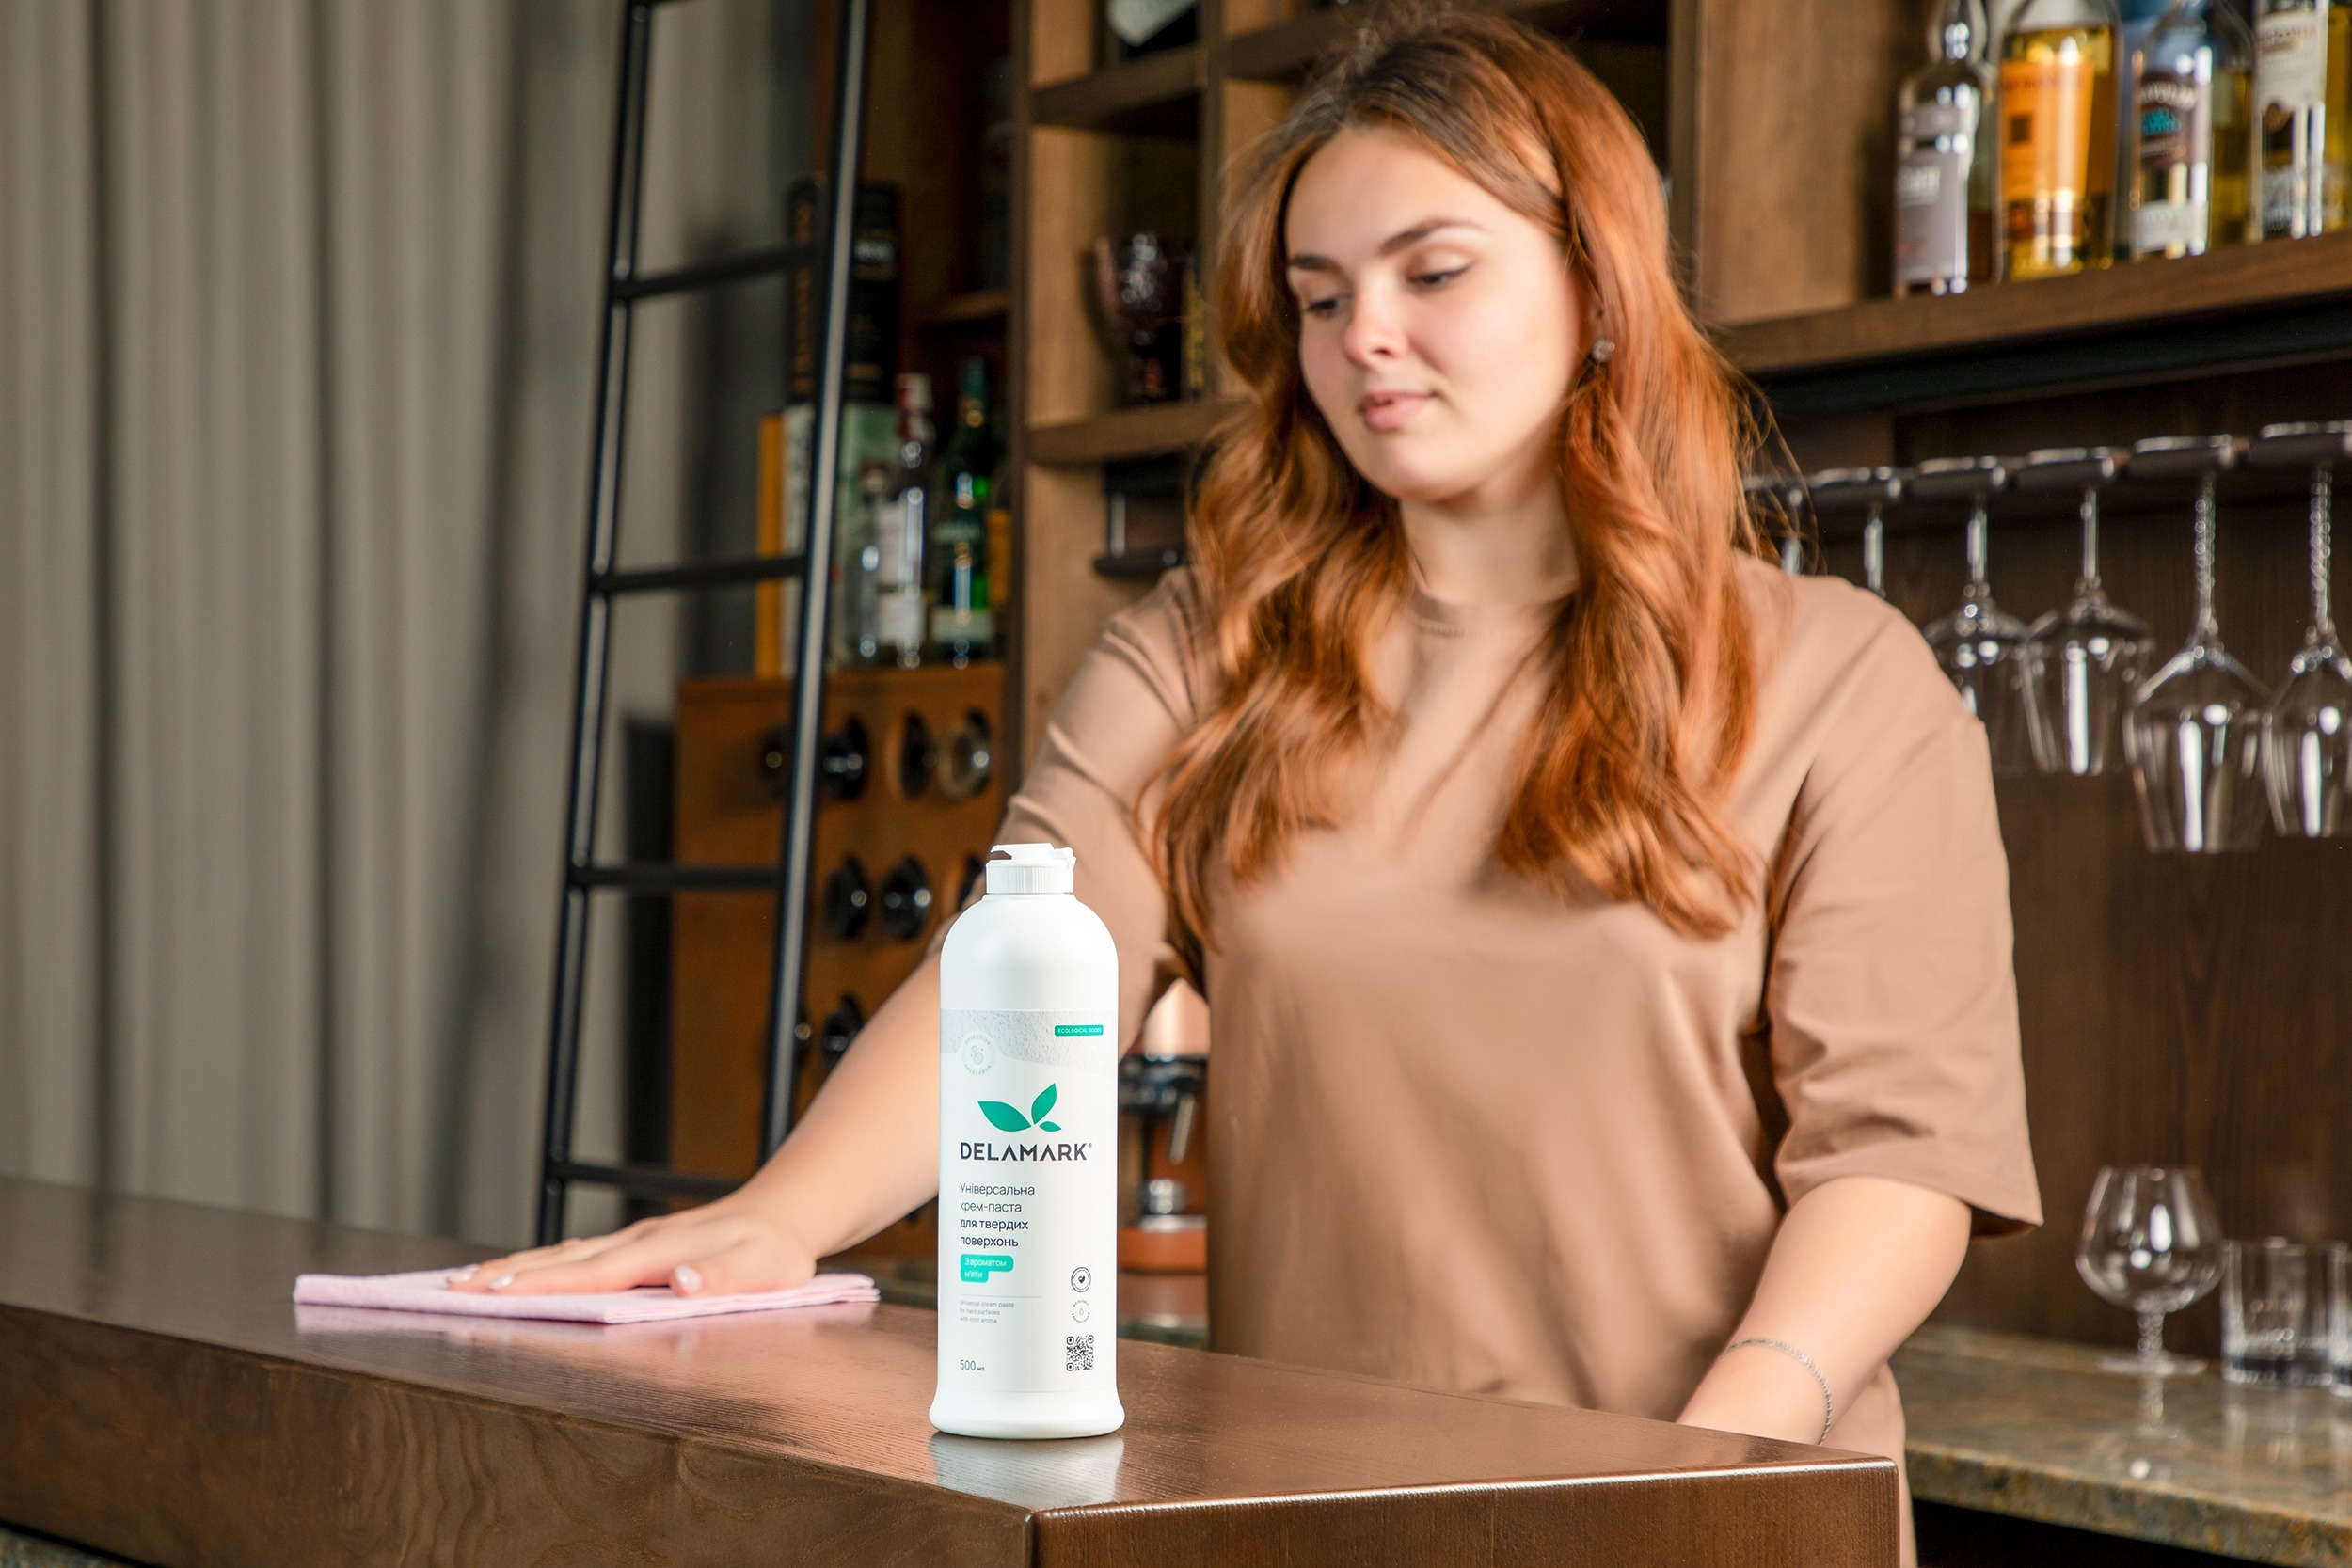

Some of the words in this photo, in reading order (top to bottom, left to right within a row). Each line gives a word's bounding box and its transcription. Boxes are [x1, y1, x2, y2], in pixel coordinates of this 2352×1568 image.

[960, 1182, 1035, 1197] Універсальна
[960, 1202, 1022, 1213] крем-паста
[960, 1219, 977, 1228] для
[979, 1220, 1028, 1232] твердих
[960, 1236, 1019, 1249] поверхонь
[970, 1259, 1007, 1268] ароматом
[960, 1359, 976, 1371] 500
